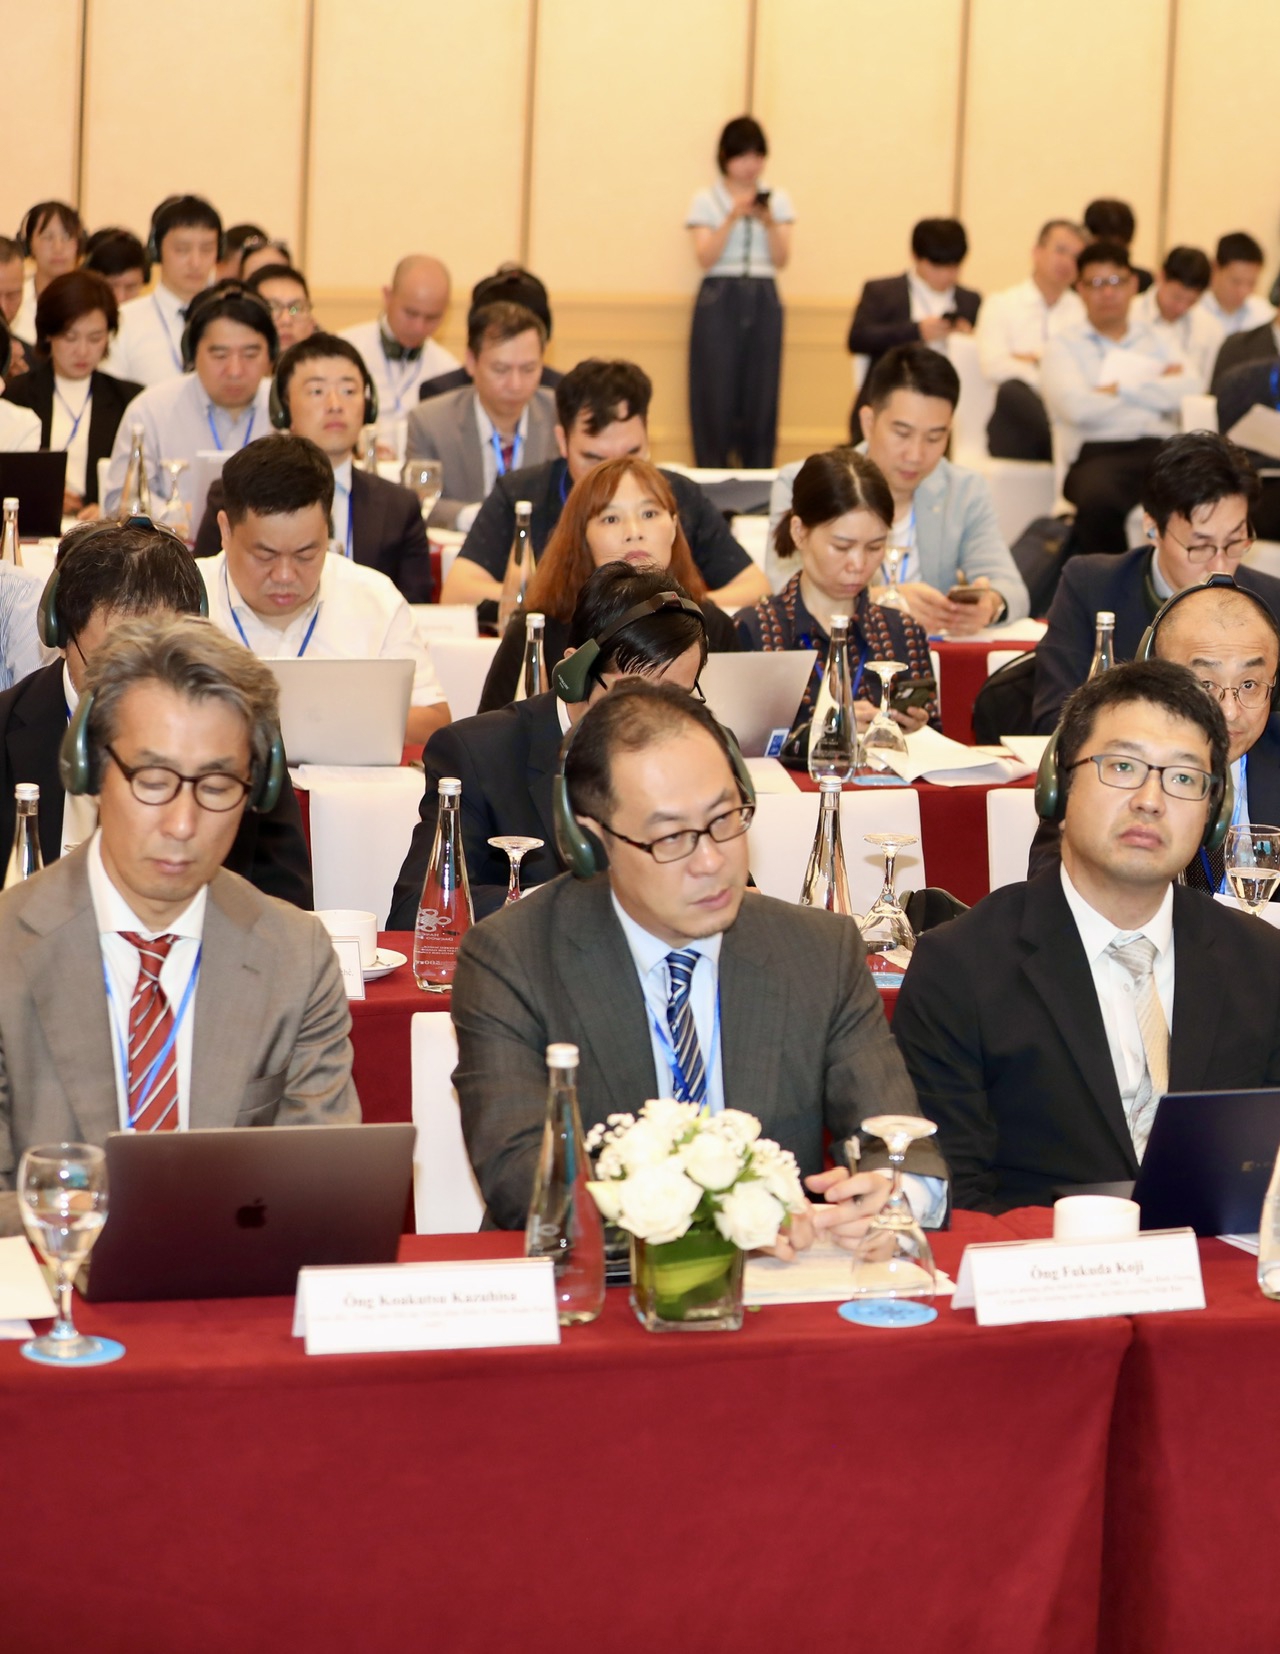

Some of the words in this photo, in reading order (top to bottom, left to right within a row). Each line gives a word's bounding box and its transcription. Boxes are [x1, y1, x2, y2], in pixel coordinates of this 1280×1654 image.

[1030, 1264, 1060, 1280] Ông
[1063, 1265, 1112, 1278] Fukuda
[1116, 1261, 1144, 1276] Koji
[344, 1290, 374, 1308] Ông
